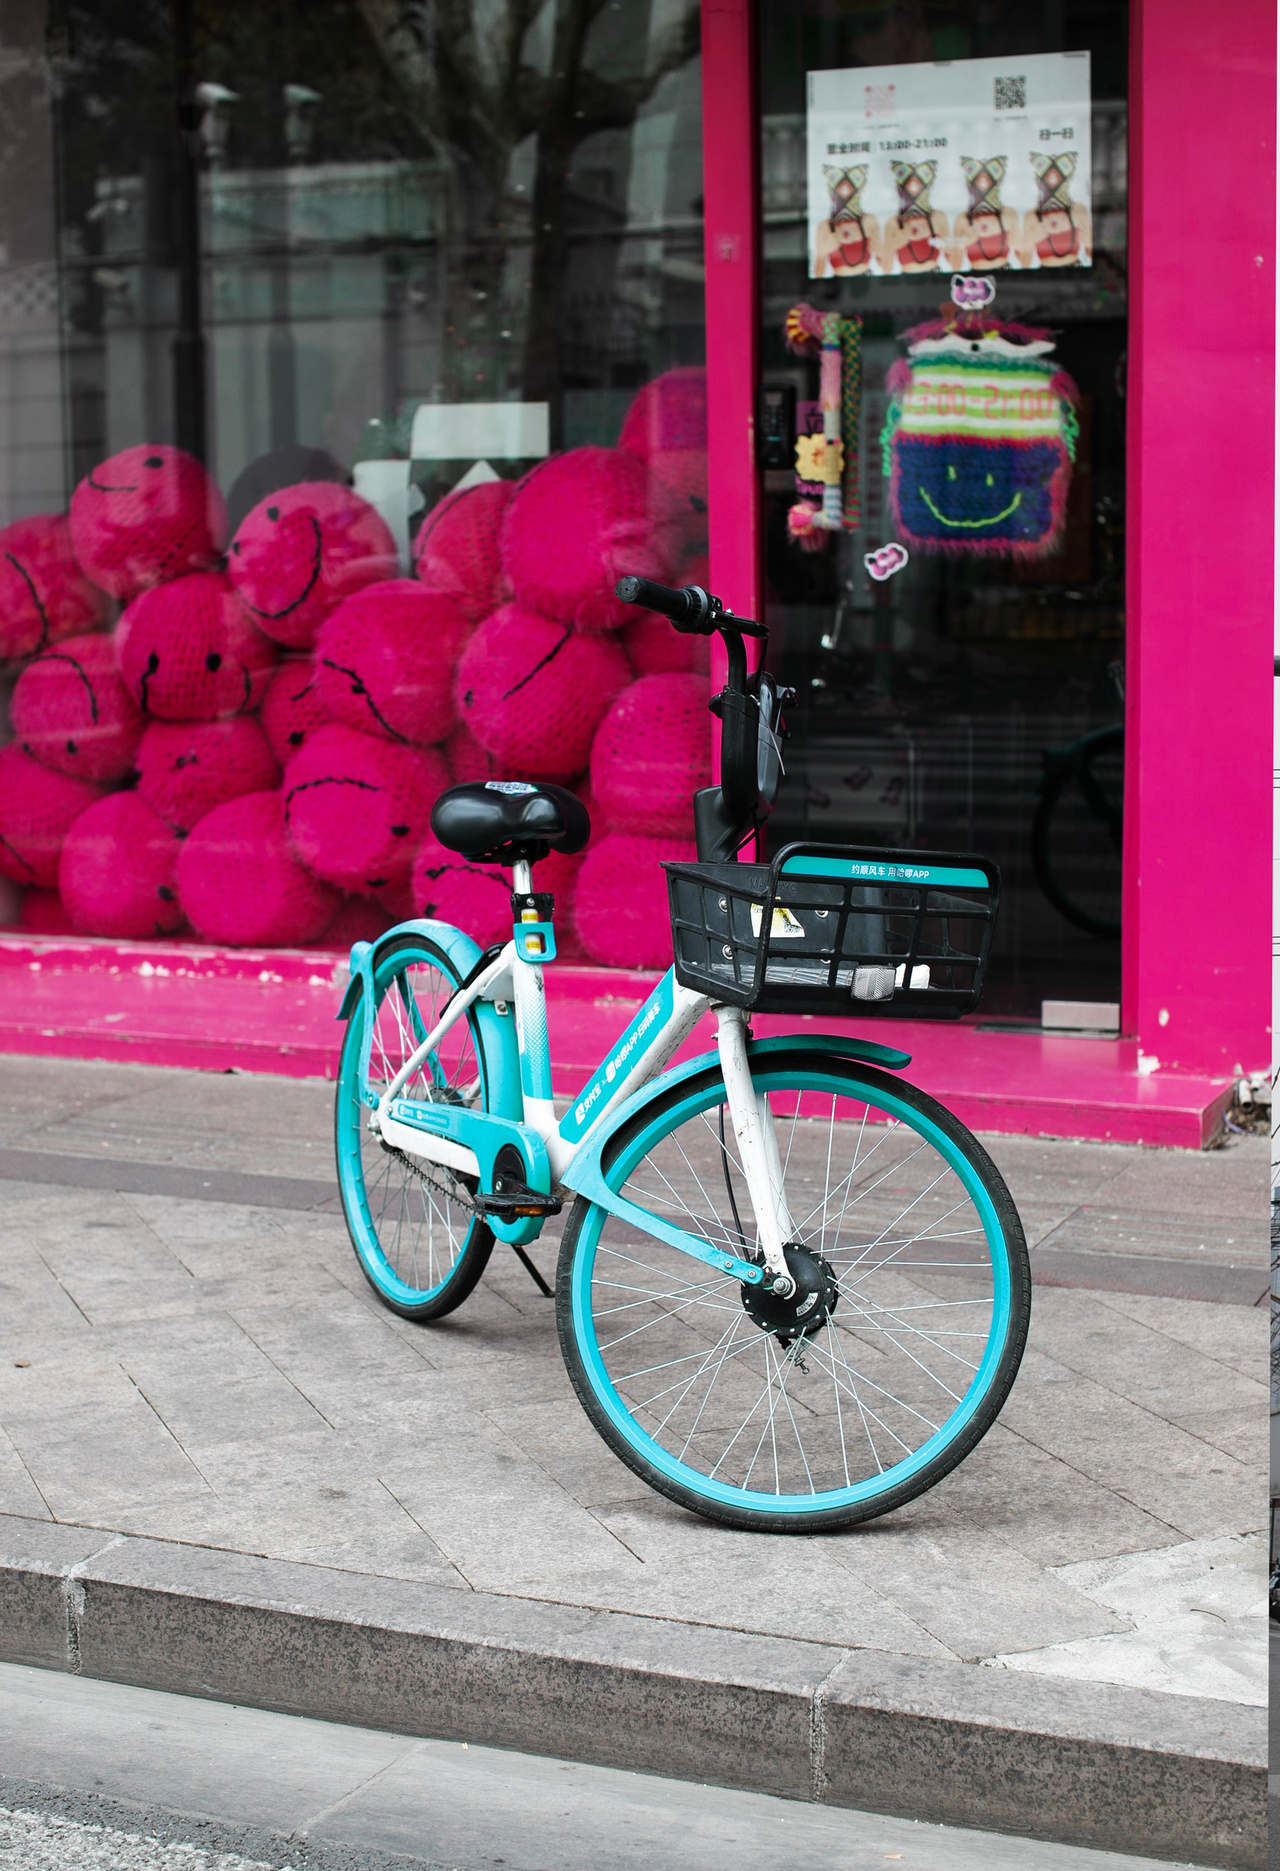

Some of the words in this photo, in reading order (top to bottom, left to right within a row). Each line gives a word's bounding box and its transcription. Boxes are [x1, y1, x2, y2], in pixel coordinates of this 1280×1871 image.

[1039, 127, 1074, 141] 扫一扫
[827, 141, 871, 155] 营业时间
[851, 864, 886, 876] 约顺风车
